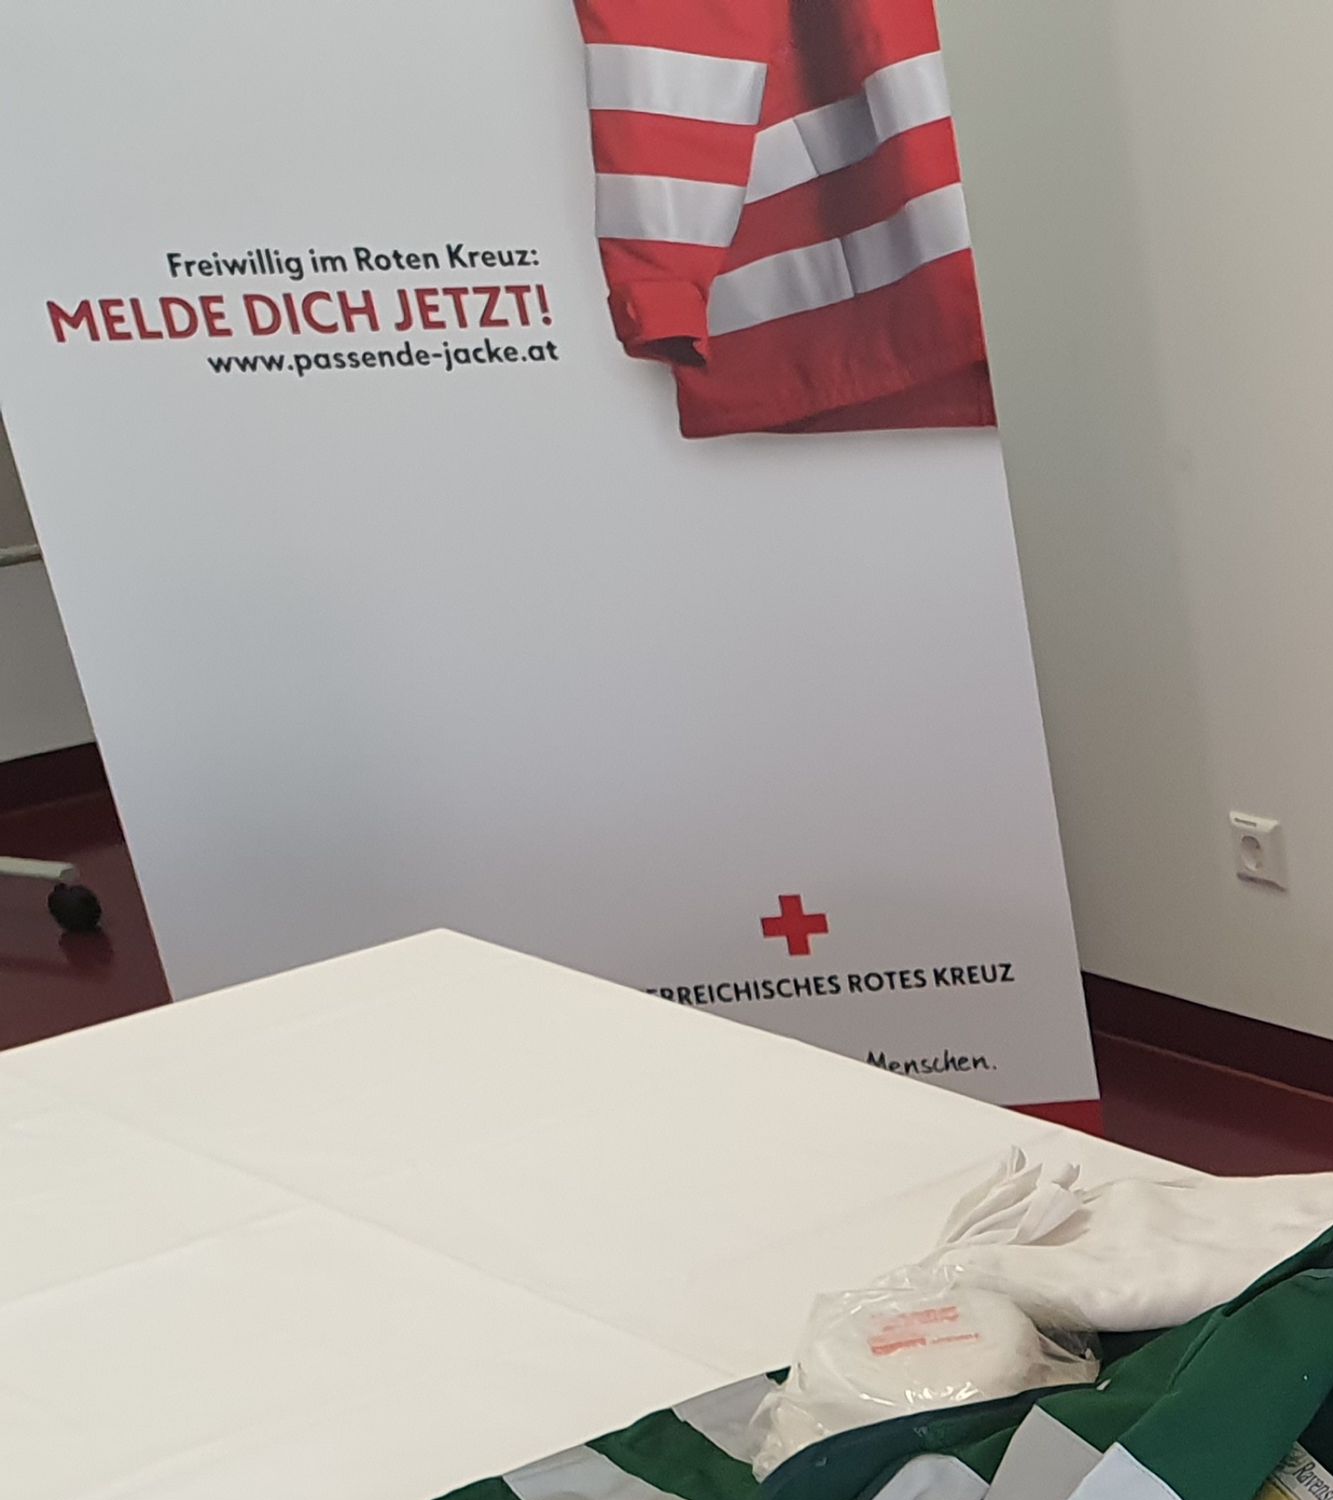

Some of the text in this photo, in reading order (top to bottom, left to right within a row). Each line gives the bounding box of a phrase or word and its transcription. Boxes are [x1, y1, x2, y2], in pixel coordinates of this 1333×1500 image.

[167, 243, 541, 281] Freiwillig im Roten Kreuz:
[46, 284, 555, 343] MELDE DICH JETZT!
[208, 339, 559, 376] www.passende-jacke.at
[848, 969, 927, 994] ROTES
[933, 963, 1015, 988] KREUZ
[867, 1049, 997, 1076] Menschen.
